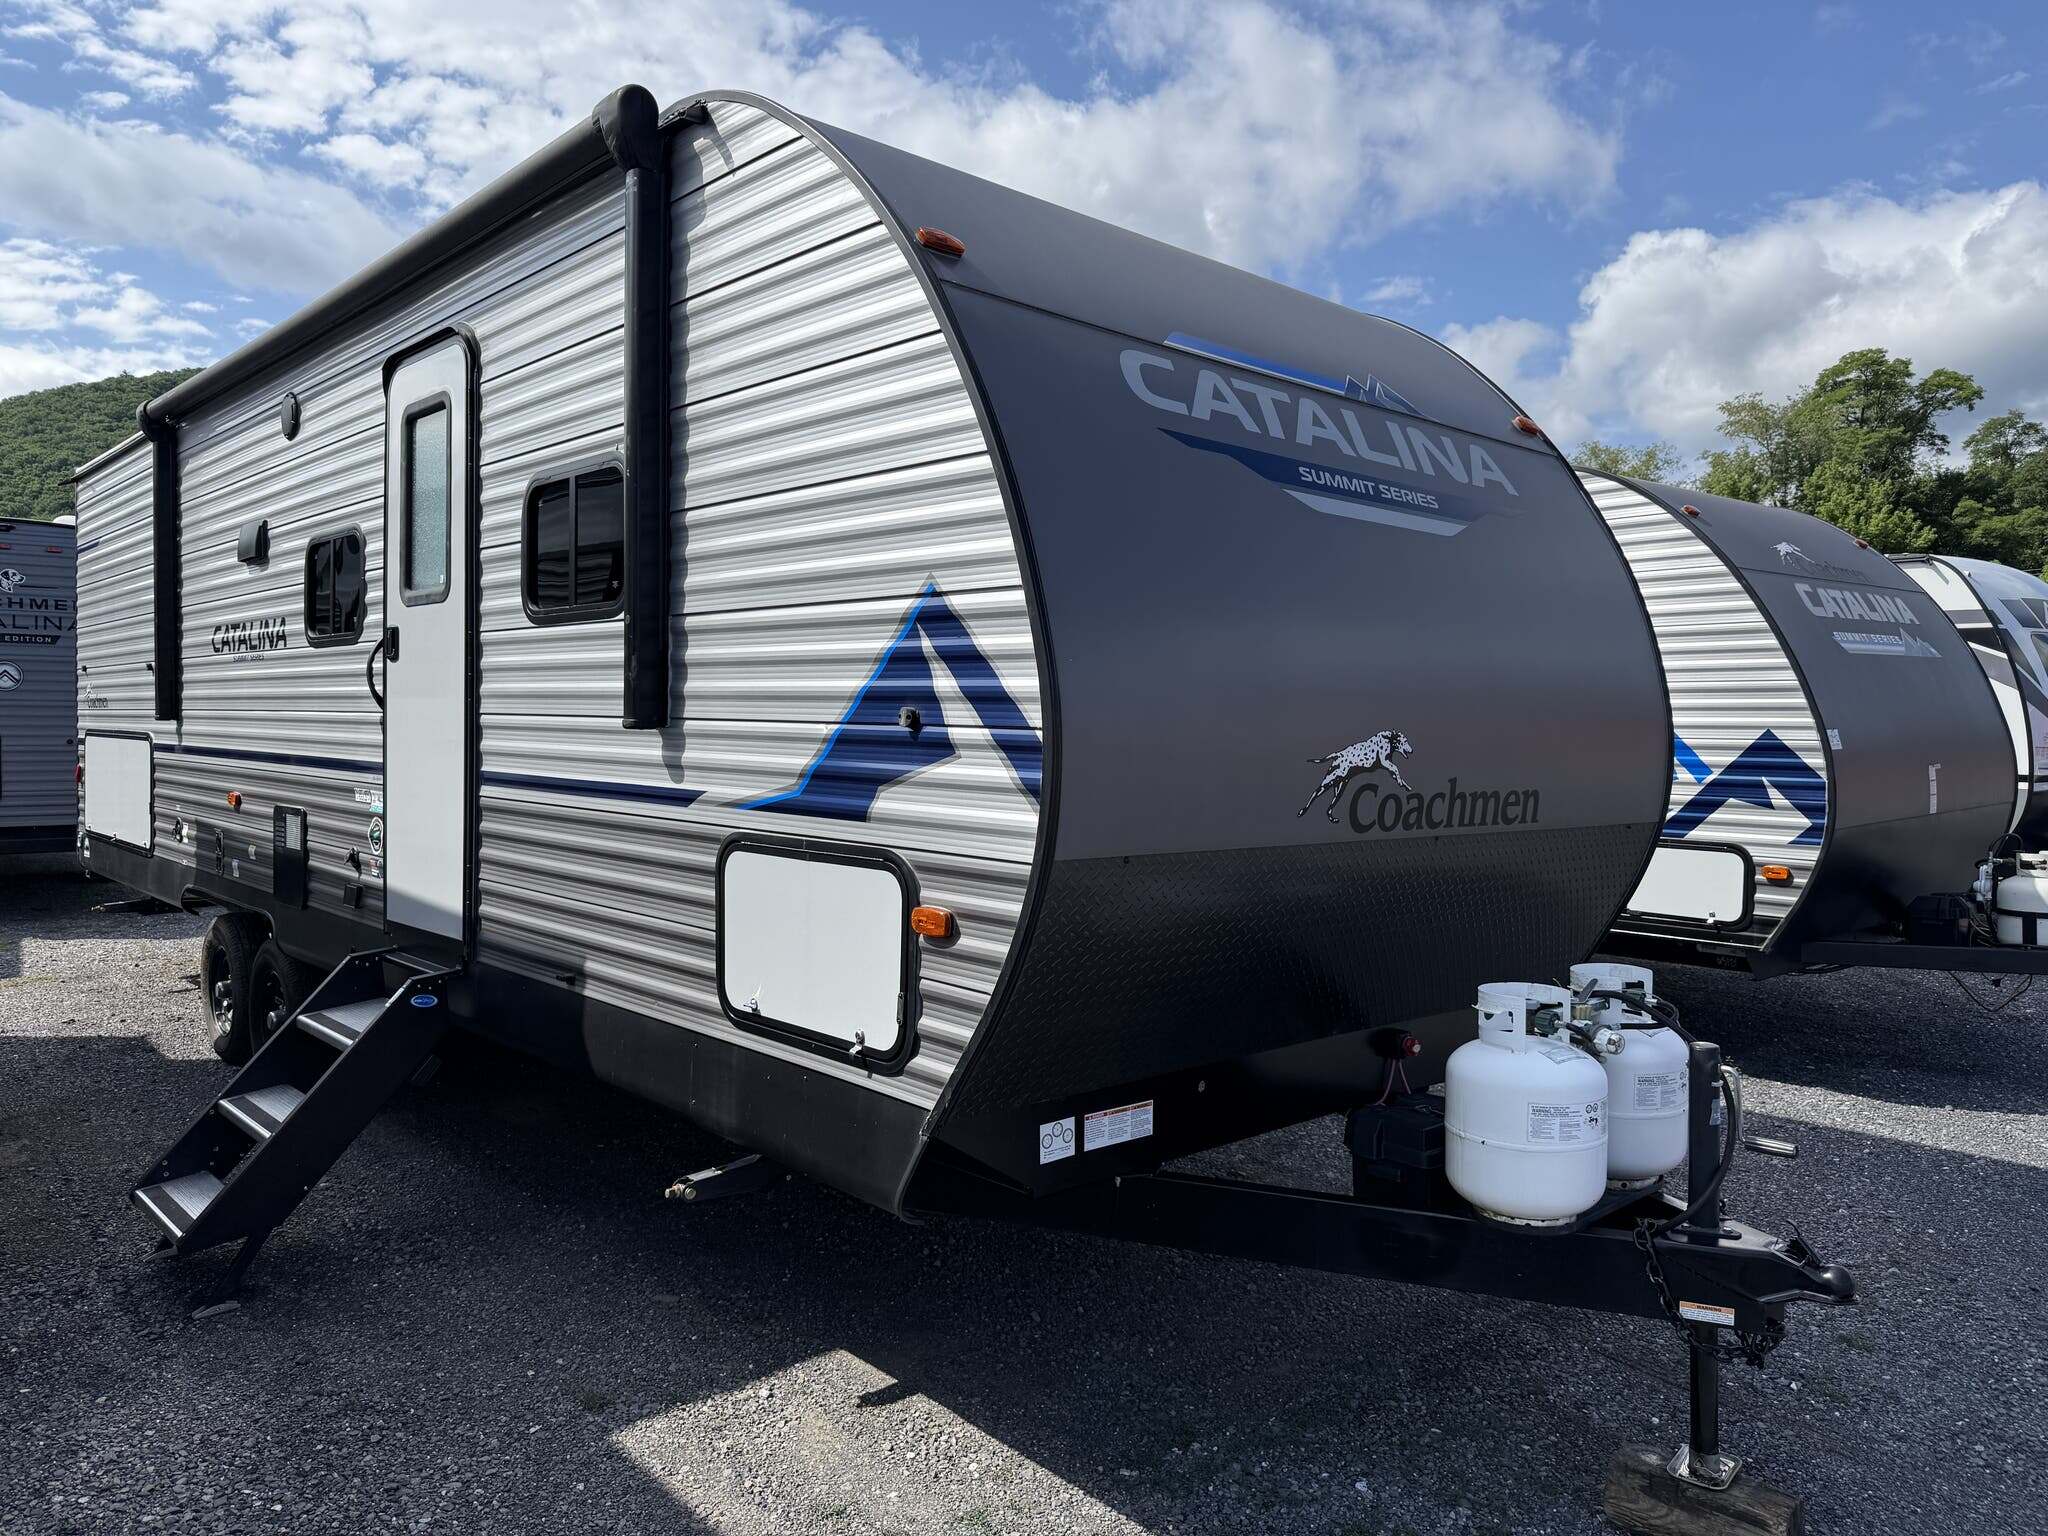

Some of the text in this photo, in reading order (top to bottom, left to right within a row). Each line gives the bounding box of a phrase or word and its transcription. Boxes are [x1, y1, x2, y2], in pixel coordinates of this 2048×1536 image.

[1120, 349, 1519, 496] CATALINA
[1299, 467, 1439, 509] SUMMIT SERIES
[0, 597, 77, 612] HME
[1794, 582, 1920, 625] CATALINA
[5, 635, 52, 643] EDITION
[212, 616, 287, 653] CATALINA
[1832, 631, 1905, 645] SUMMIT SERIES
[1350, 777, 1540, 834] Coachmen
